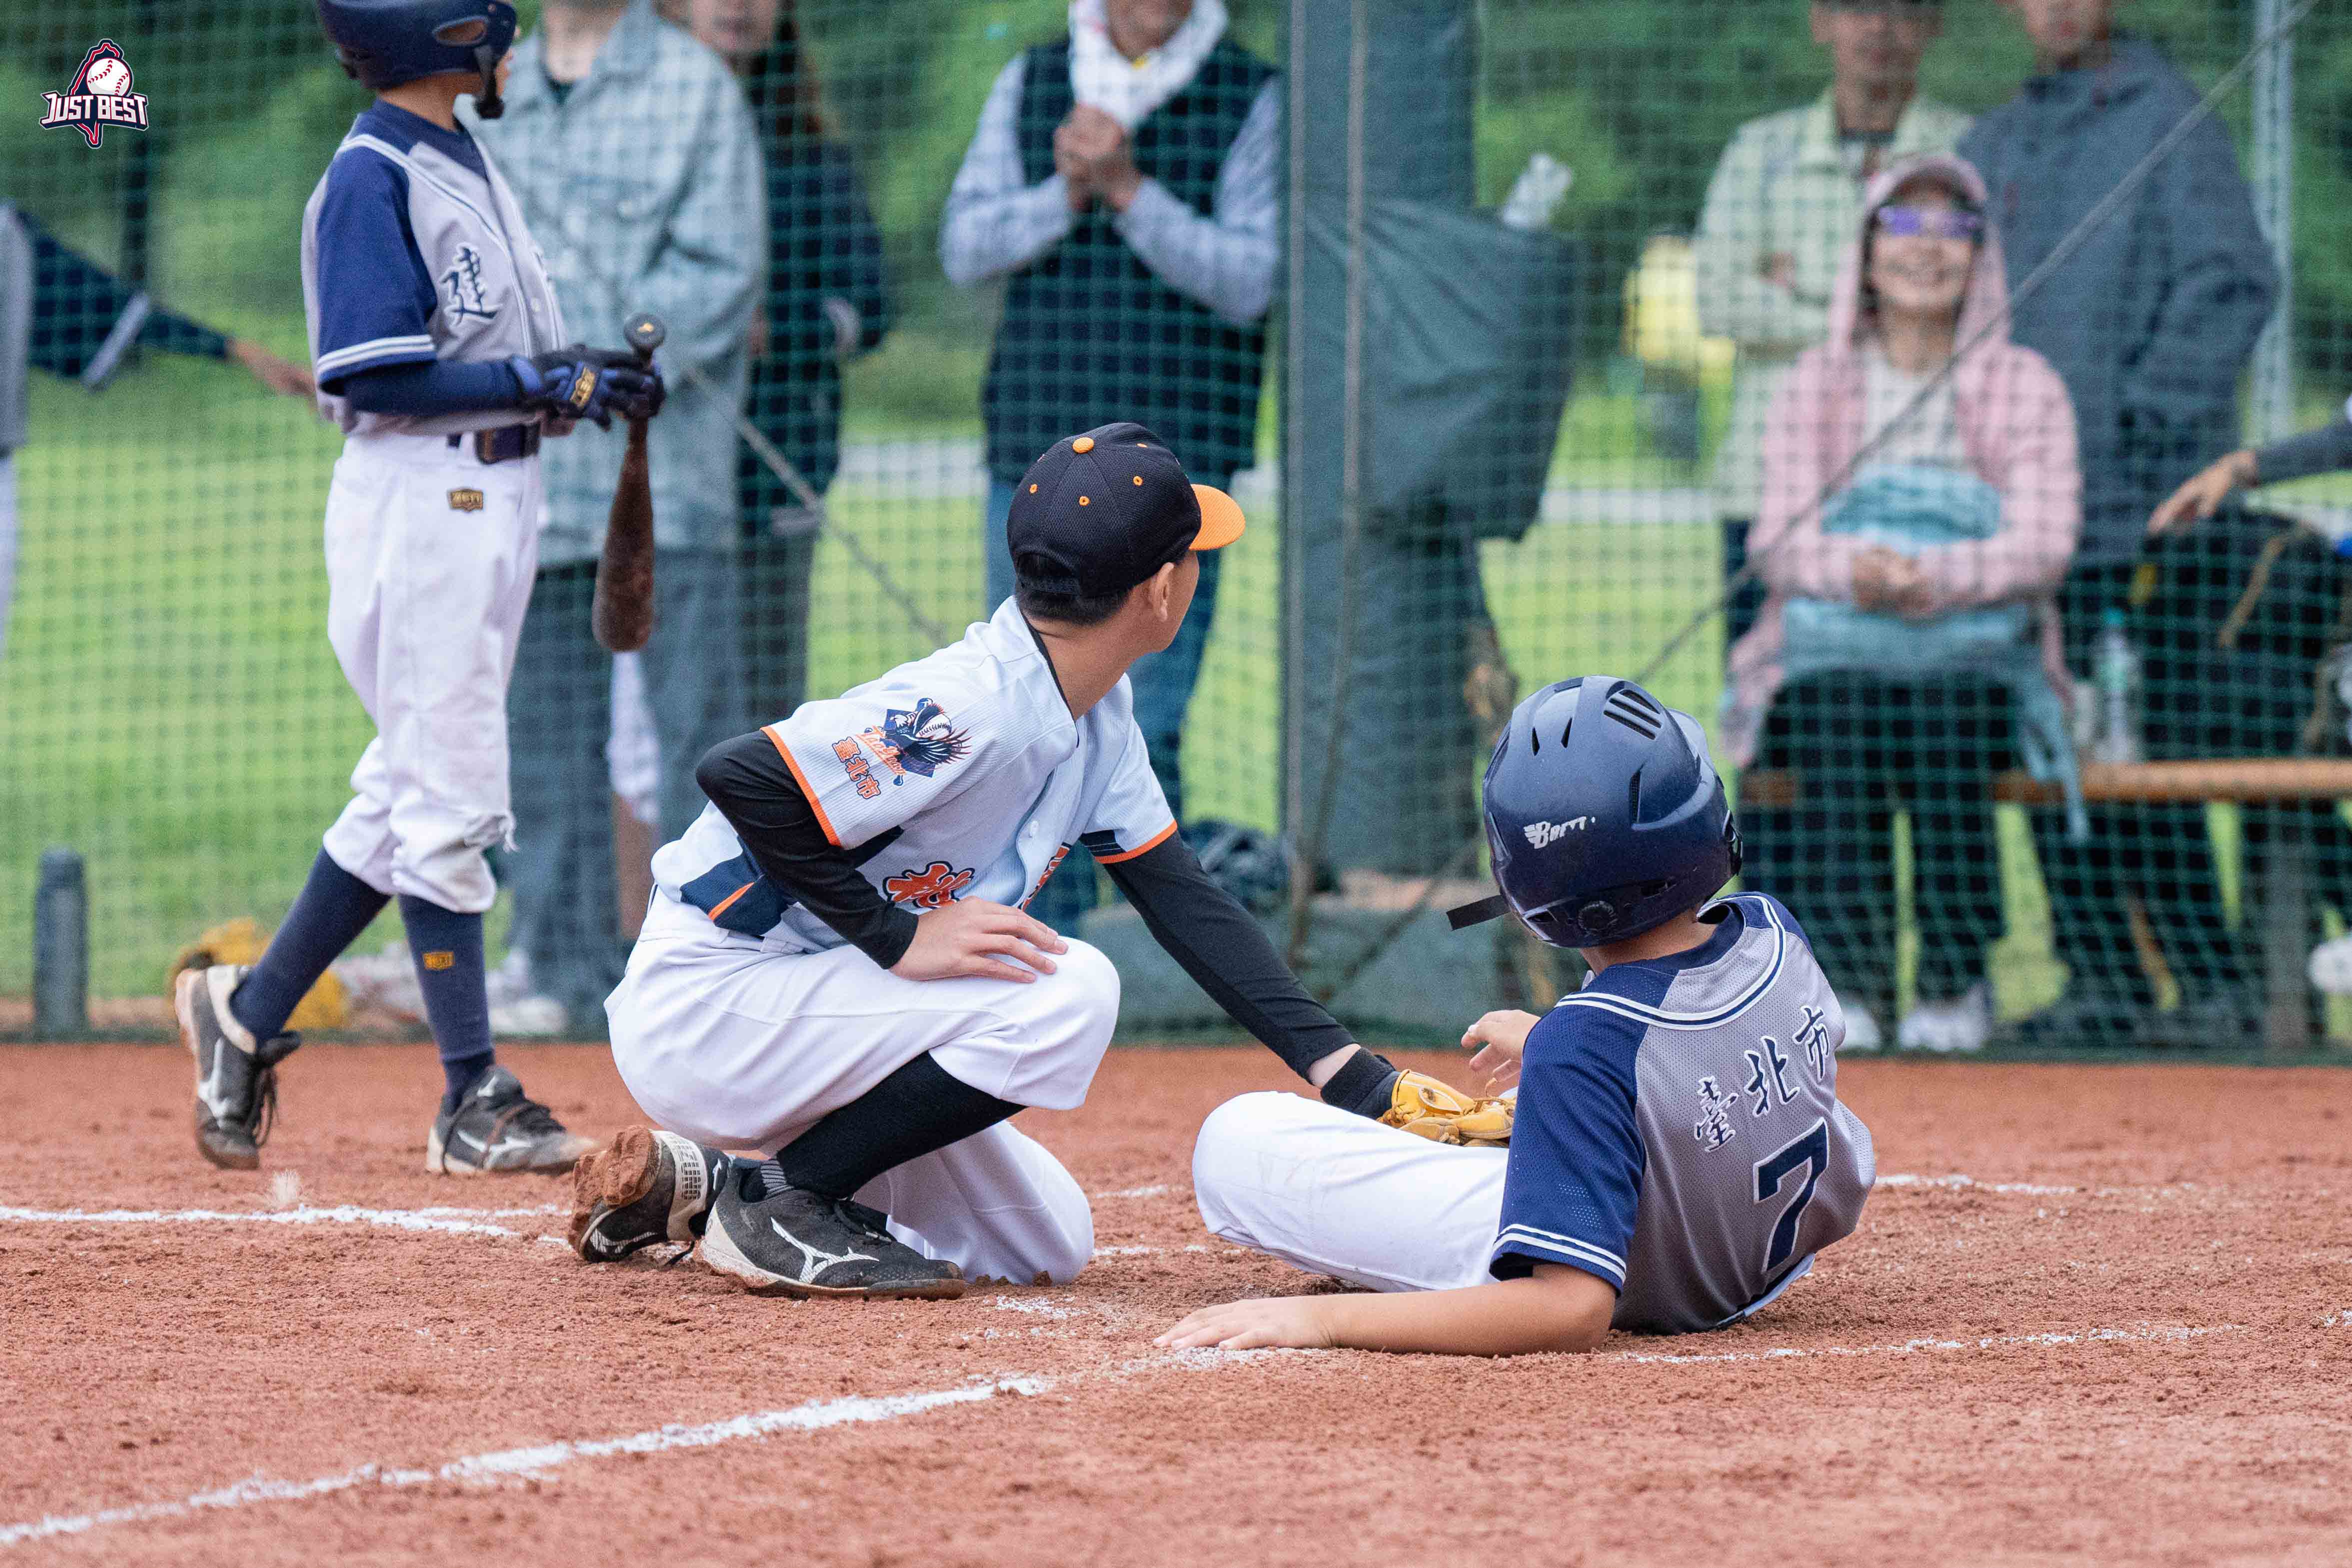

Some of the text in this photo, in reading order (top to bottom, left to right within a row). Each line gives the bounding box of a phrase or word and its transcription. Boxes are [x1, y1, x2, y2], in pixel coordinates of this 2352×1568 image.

[832, 736, 881, 799] 臺北市
[1694, 1005, 1830, 1153] 臺北市
[1753, 1116, 1830, 1274] 7
